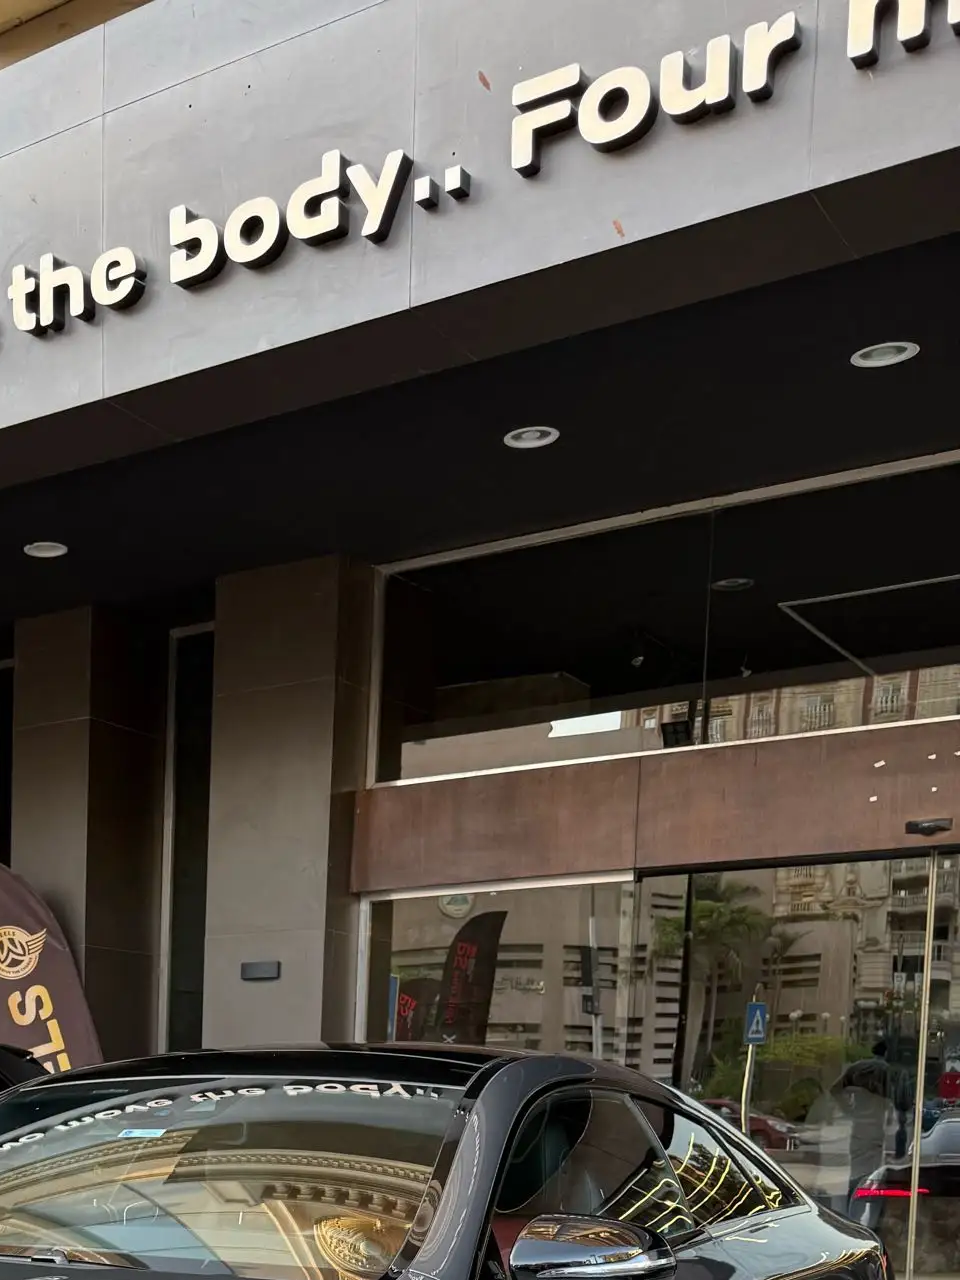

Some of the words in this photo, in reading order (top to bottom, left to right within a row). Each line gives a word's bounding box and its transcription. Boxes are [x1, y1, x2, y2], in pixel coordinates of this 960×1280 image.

[7, 246, 143, 334] the
[169, 148, 468, 286] body..
[511, 11, 799, 174] Four
